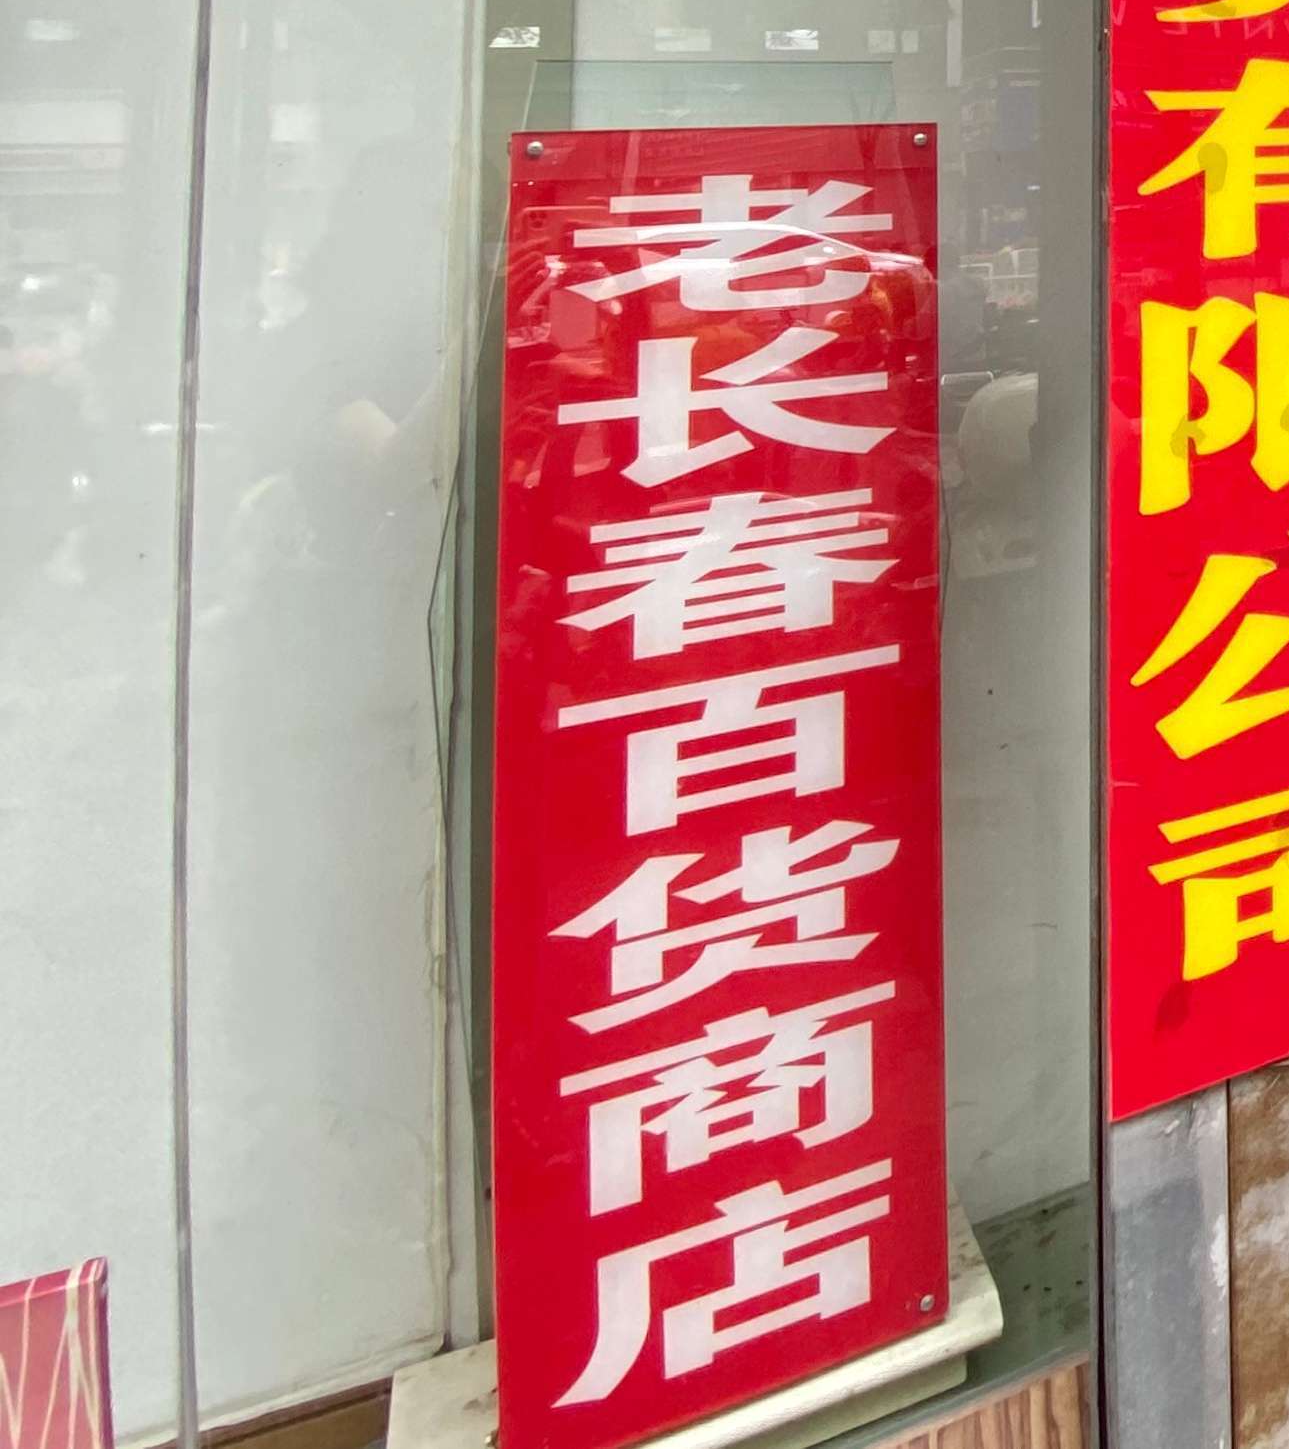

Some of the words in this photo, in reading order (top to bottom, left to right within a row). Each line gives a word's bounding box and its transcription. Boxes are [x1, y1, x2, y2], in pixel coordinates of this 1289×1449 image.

[548, 175, 900, 1409] 老长春百货商店
